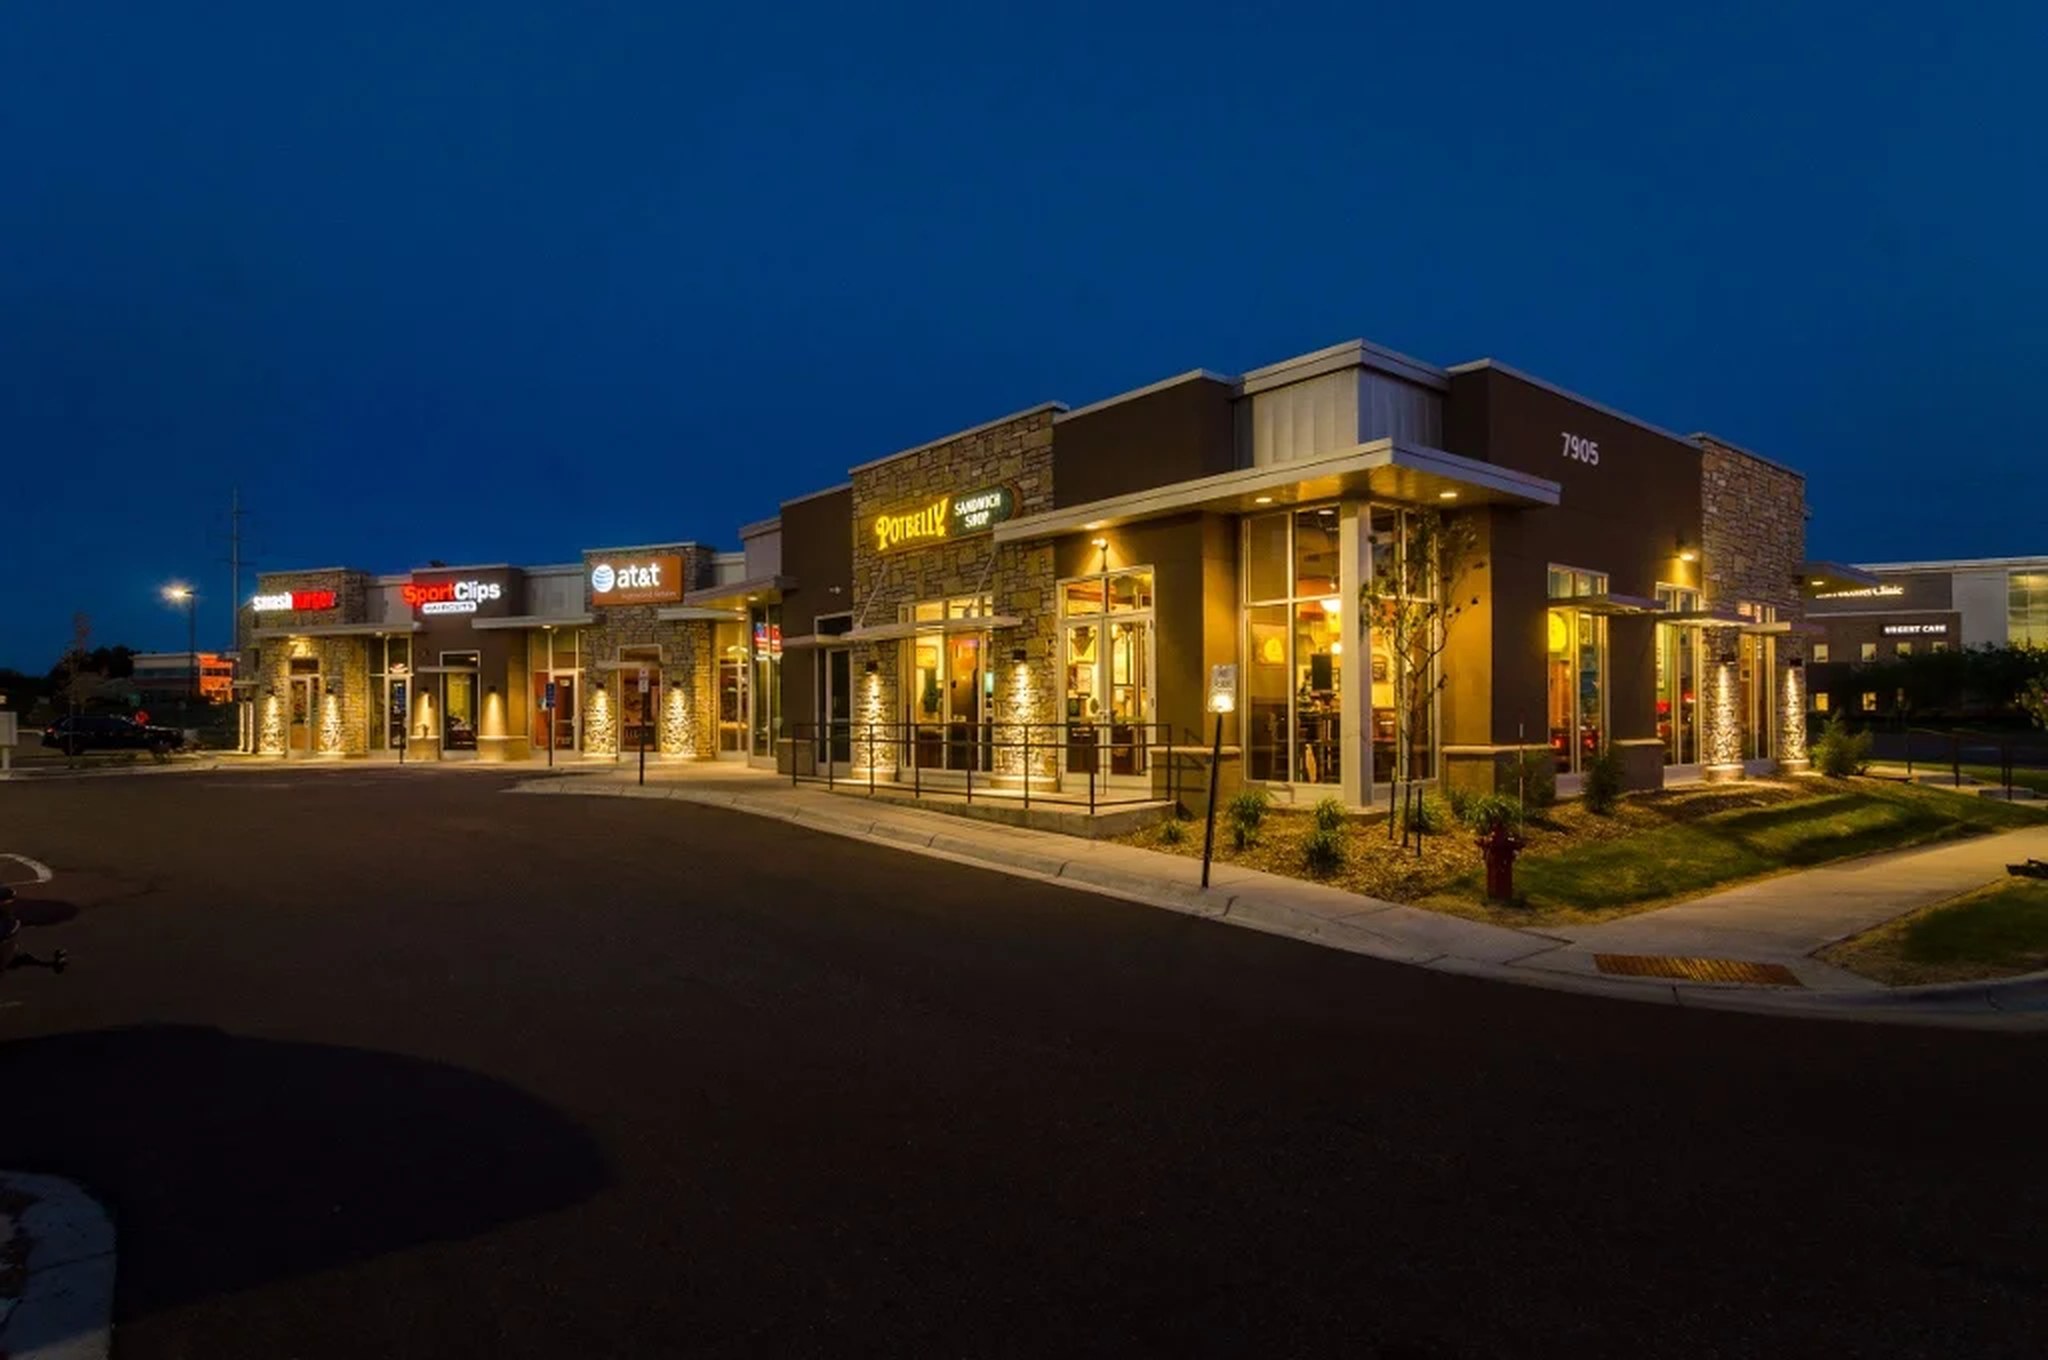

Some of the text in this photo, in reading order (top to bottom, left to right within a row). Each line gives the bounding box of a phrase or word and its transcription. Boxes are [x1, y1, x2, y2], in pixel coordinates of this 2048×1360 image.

[1561, 432, 1599, 466] 7905
[954, 493, 1001, 517] SANDWICH
[875, 497, 948, 551] POTBELLY
[964, 510, 990, 529] SHOP
[617, 562, 660, 589] at&t
[1922, 624, 1946, 633] CARE
